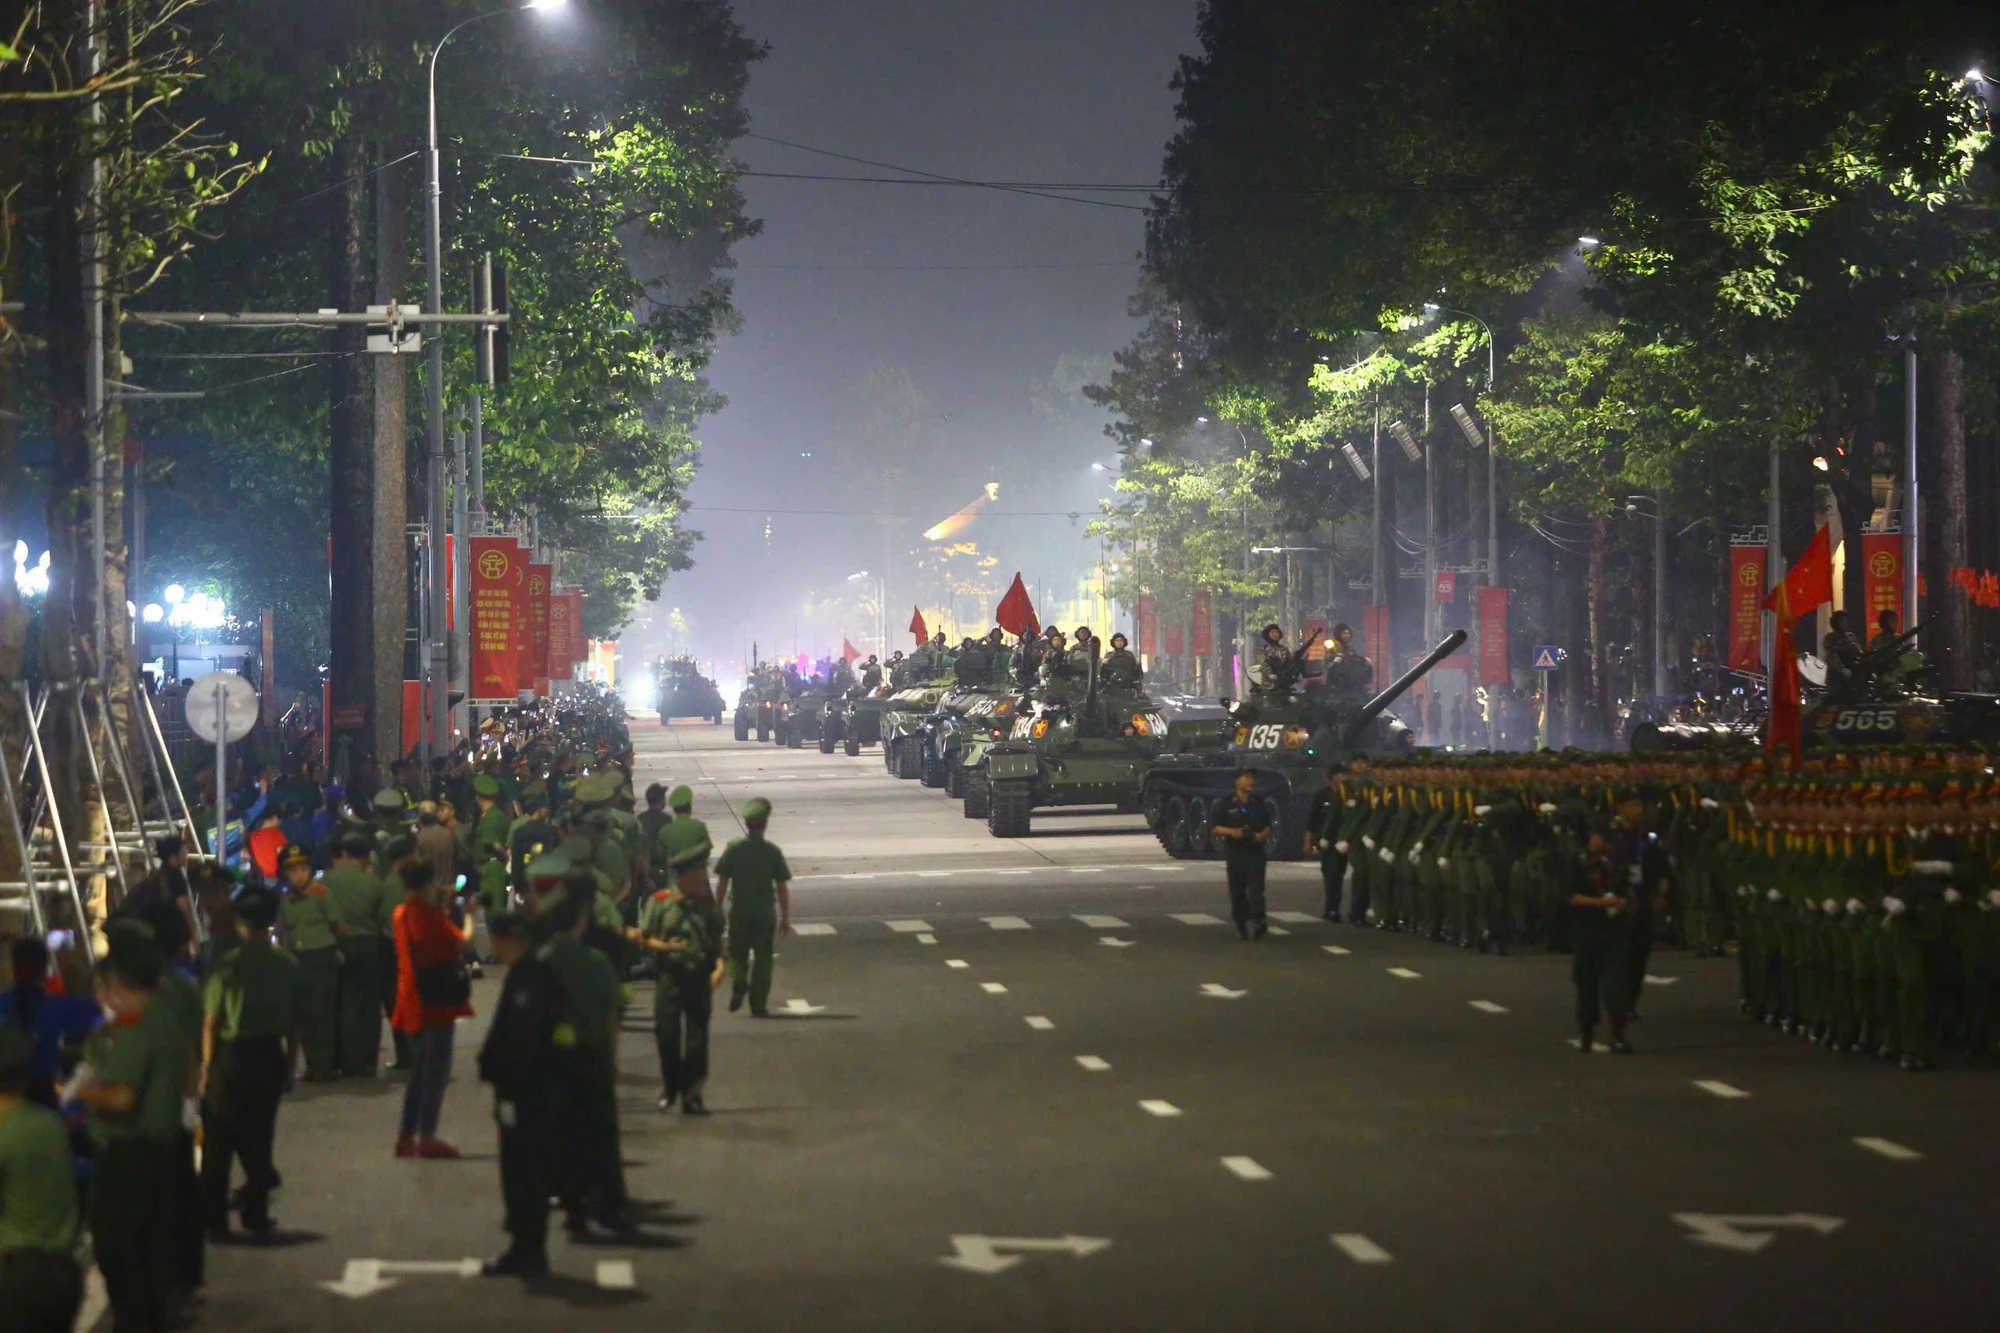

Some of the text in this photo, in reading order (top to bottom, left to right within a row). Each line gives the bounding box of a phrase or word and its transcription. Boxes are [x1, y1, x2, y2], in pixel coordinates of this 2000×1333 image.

[1014, 716, 1037, 738] 134
[1144, 713, 1168, 735] 134
[1836, 710, 1898, 730] 565
[1248, 724, 1285, 749] 135
